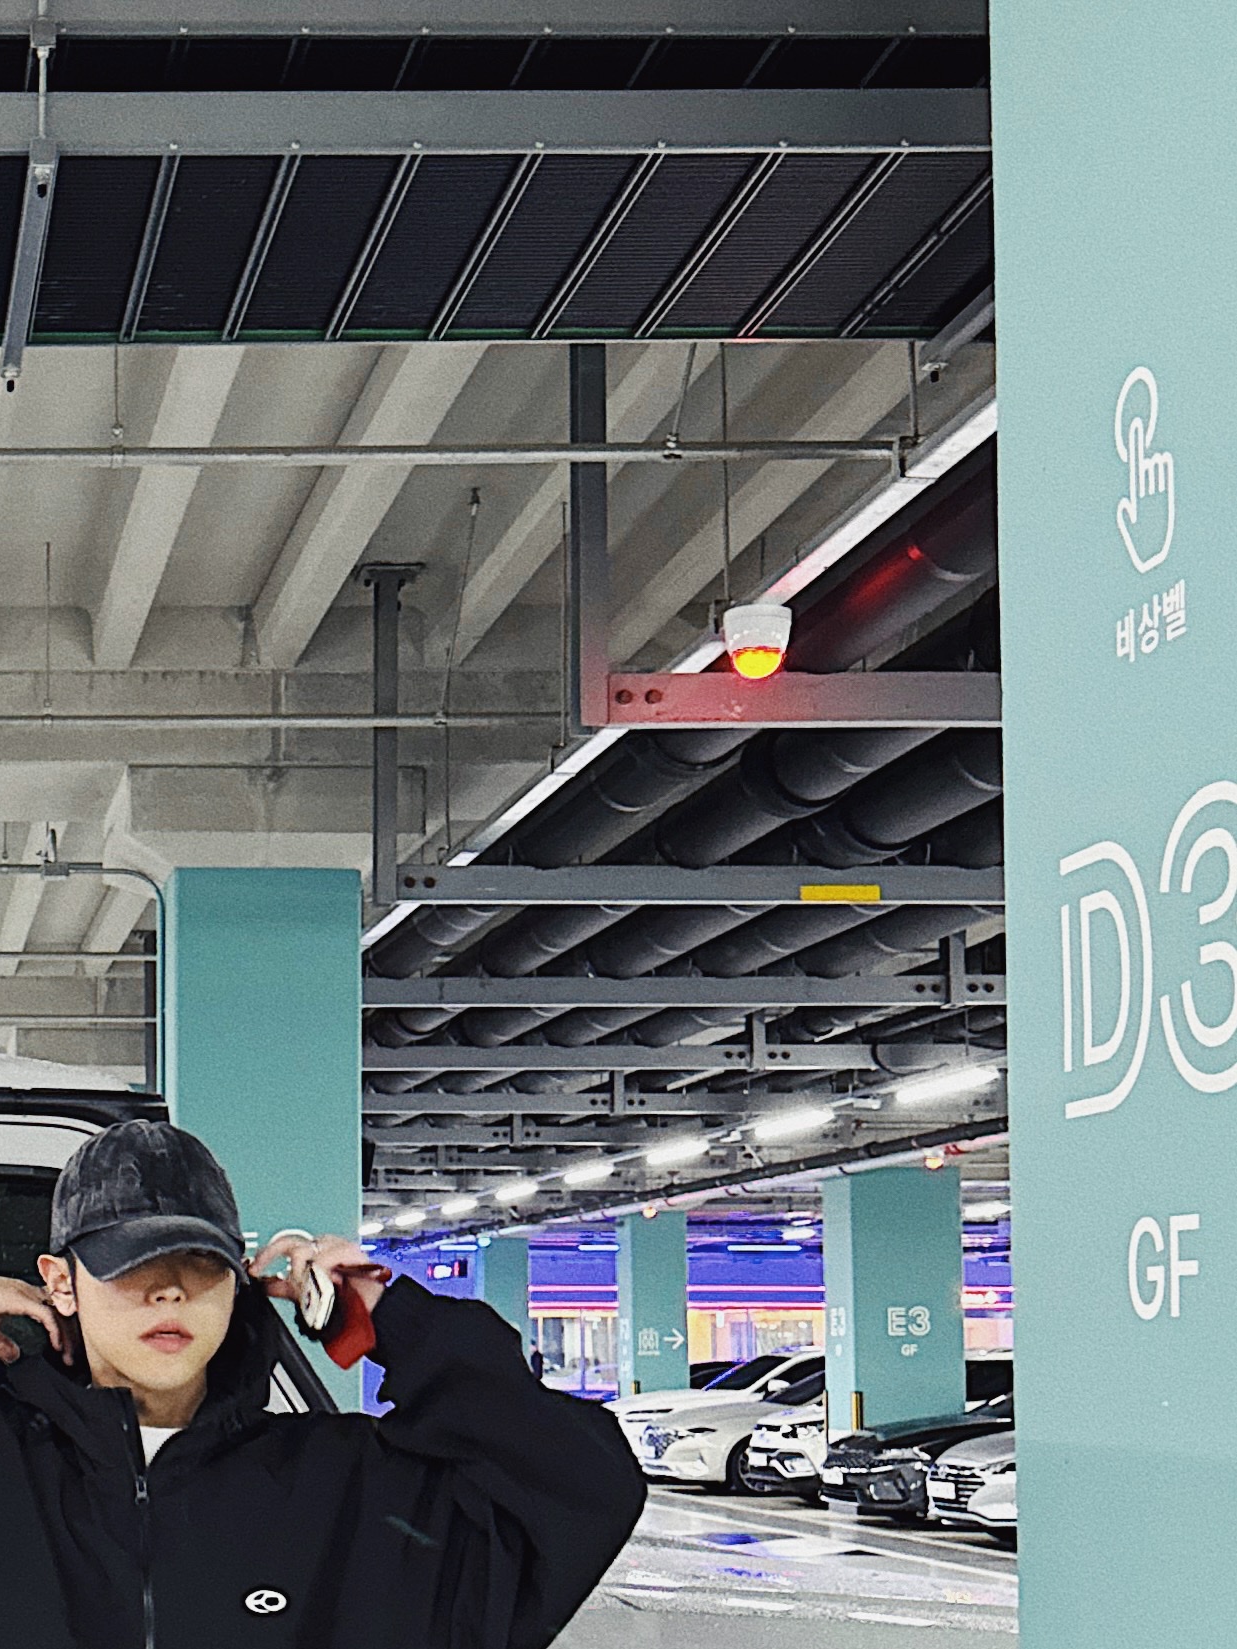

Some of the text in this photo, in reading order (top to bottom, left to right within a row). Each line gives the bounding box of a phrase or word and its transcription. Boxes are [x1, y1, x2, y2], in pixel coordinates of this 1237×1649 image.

[1116, 579, 1186, 662] 비상벨
[1060, 780, 1237, 1120] D3
[1128, 1213, 1200, 1321] GF
[887, 1306, 931, 1337] E3
[900, 1343, 919, 1356] GF
